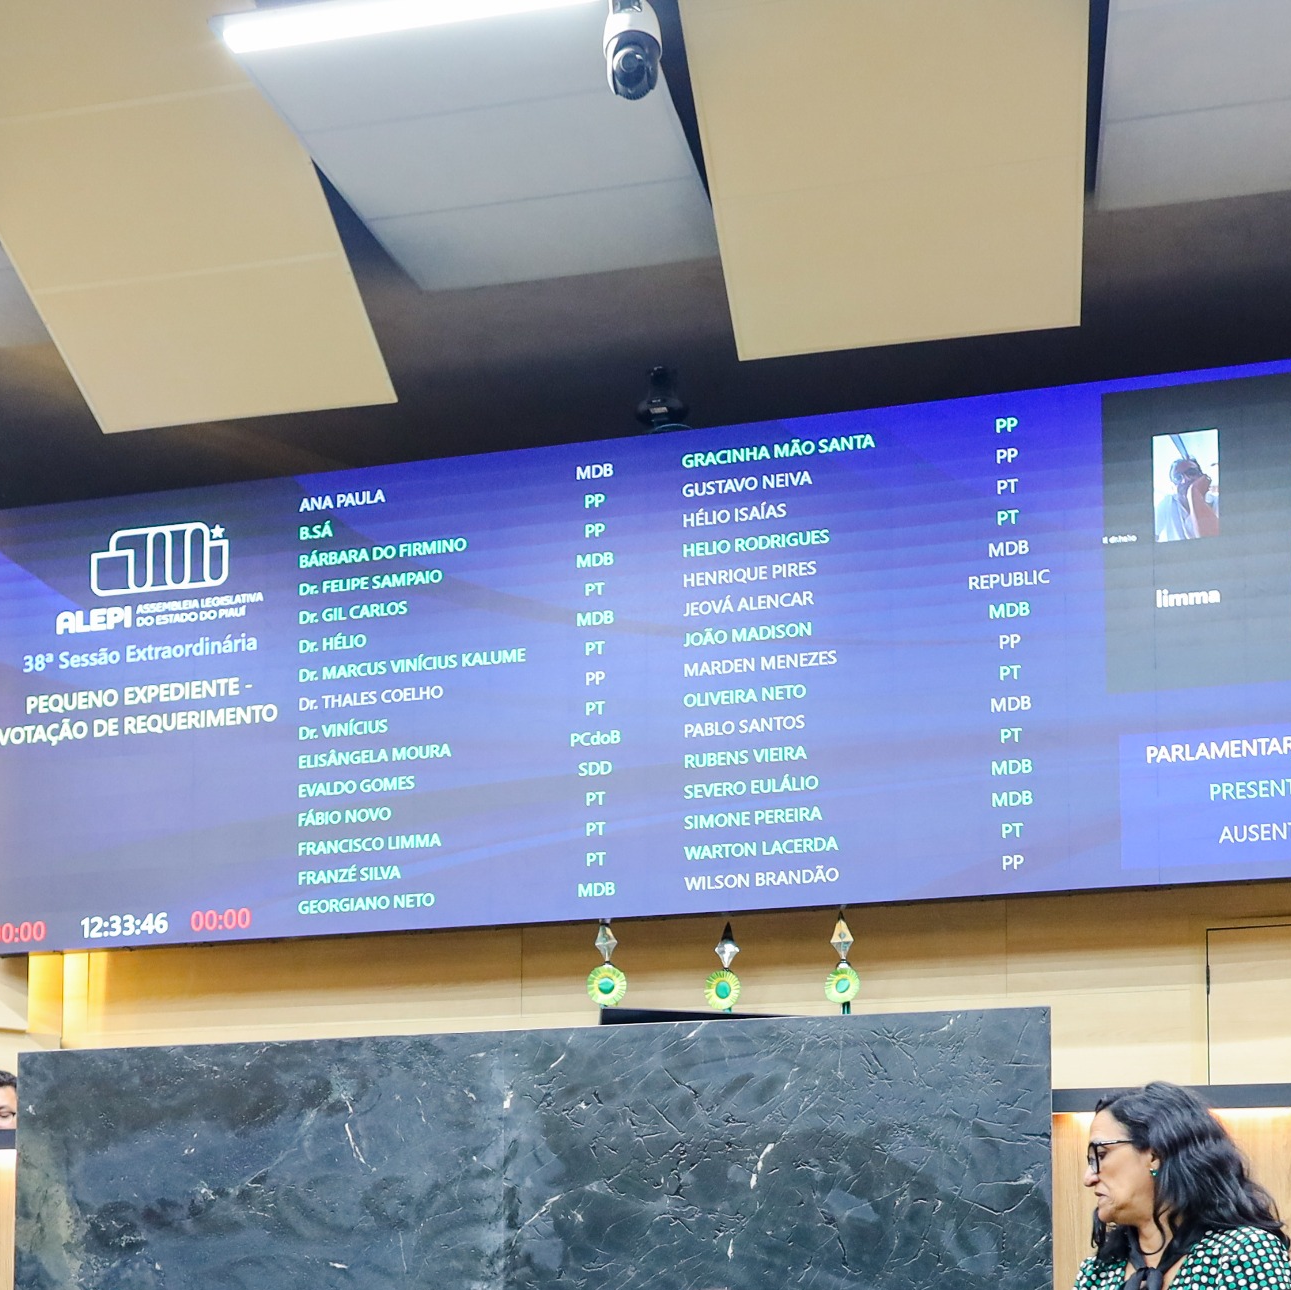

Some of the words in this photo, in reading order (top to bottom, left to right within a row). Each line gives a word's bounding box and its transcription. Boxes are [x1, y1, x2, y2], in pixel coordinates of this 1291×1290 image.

[995, 416, 1019, 434] PP
[681, 445, 771, 469] GRACINHA
[773, 438, 816, 459] MÃO
[817, 433, 876, 454] SANTA
[996, 447, 1019, 465] PP
[575, 462, 614, 481] MDB
[681, 476, 759, 498] GUSTAVO
[762, 470, 813, 490] NEIVA
[996, 478, 1019, 495] PT
[298, 494, 335, 513] ANA
[336, 489, 386, 509] PAULA
[584, 493, 606, 509] PP
[682, 508, 731, 528] HÉLIO
[734, 501, 787, 523] ISAÍAS
[997, 509, 1020, 526] PT
[299, 520, 334, 541] B.SÁ
[584, 522, 606, 538] PP
[299, 547, 370, 569] BÁRBARA
[372, 544, 397, 561] DO
[398, 537, 468, 558] FIRMINO
[683, 539, 731, 558] HELIO
[734, 529, 830, 552] RODRIGUES
[988, 539, 1030, 558] MDB
[576, 551, 614, 569] MDB
[298, 582, 320, 596] Dr.
[322, 576, 370, 594] FELIPE
[371, 569, 443, 590] SAMPAIO
[683, 565, 768, 588] HENRIQUE
[772, 560, 817, 579] PIRES
[968, 569, 1050, 590] REPUBLIC
[585, 582, 605, 596] PT
[1156, 589, 1221, 608] limma
[136, 599, 200, 615] ASSEMBLEIA
[200, 592, 265, 608] LEGISLATIVA
[299, 610, 319, 625] Dr.
[321, 607, 348, 622] GIL
[348, 600, 408, 620] CARLOS
[683, 594, 734, 617] JEOVÁ
[737, 590, 815, 612] ALENCAR
[989, 601, 1030, 620] MDB
[56, 605, 132, 636] ALEPI
[136, 615, 154, 627] DO
[156, 611, 198, 626] ESTADO
[199, 610, 217, 622] DO
[218, 605, 247, 619] PIAUÍ
[577, 610, 614, 627] MDB
[299, 639, 319, 654] Dr.
[322, 632, 367, 651] HÉLIO
[683, 627, 728, 648] JOÃO
[731, 621, 812, 643] MADISON
[999, 633, 1021, 650] PP
[22, 652, 55, 673] 38ª
[58, 647, 121, 670] Sessão
[126, 632, 257, 663] Extraordinária
[585, 641, 606, 656] PT
[298, 668, 319, 683] Dr.
[322, 660, 387, 680] MARCUS
[389, 653, 458, 674] VINÍCIUS
[461, 647, 526, 667] KALUME
[684, 657, 755, 677] MARDEN
[760, 650, 837, 671] MENEZES
[999, 664, 1021, 681] PT
[586, 671, 606, 686] PP
[26, 688, 119, 715] PEQUENO
[124, 677, 240, 706] EXPEDIENTE
[298, 697, 318, 711] Dr.
[321, 690, 377, 709] THALES
[380, 685, 444, 703] COELHO
[684, 688, 758, 708] OLIVEIRA
[762, 684, 807, 702] NETO
[990, 695, 1032, 713] MDB
[585, 701, 605, 716] PT
[93, 717, 119, 738] DE
[124, 703, 278, 735] REQUERIMENTO
[298, 726, 319, 741] Dr.
[321, 718, 388, 738] VINÍCIUS
[685, 720, 735, 738] PABLO
[739, 714, 805, 734] SANTOS
[570, 729, 621, 747] PCdoB
[1000, 727, 1022, 744] PT
[298, 748, 389, 769] ELISÂNGELA
[392, 743, 452, 762] MOURA
[684, 749, 749, 769] RUBENS
[752, 745, 807, 763] VIEIRA
[991, 758, 1033, 776] MDB
[578, 760, 612, 777] SDD
[298, 780, 357, 798] EVALDO
[359, 775, 415, 793] GOMES
[684, 781, 747, 800] SEVERO
[750, 773, 819, 794] EULÁLIO
[586, 791, 606, 806] PT
[992, 790, 1033, 808] MDB
[298, 808, 342, 827] FÁBIO
[345, 806, 392, 824] NOVO
[684, 811, 751, 830] SIMONE
[754, 806, 823, 825] PEREIRA
[586, 821, 606, 837] PT
[1001, 822, 1024, 839] PT
[298, 836, 384, 856] FRANCISCO
[387, 833, 442, 850] LIMMA
[684, 841, 757, 860] WARTON
[762, 836, 839, 856] LACERDA
[586, 851, 606, 867] PT
[1002, 854, 1024, 871] PP
[298, 864, 357, 886] FRANZÉ
[359, 865, 402, 882] SILVA
[684, 873, 750, 891] WILSON
[755, 865, 839, 887] BRANDÃO
[578, 881, 616, 898] MDB
[298, 895, 391, 915] GEORGIANO
[393, 892, 435, 909] NETO
[80, 912, 169, 939] 12:33:46
[190, 907, 253, 933] 00:00
